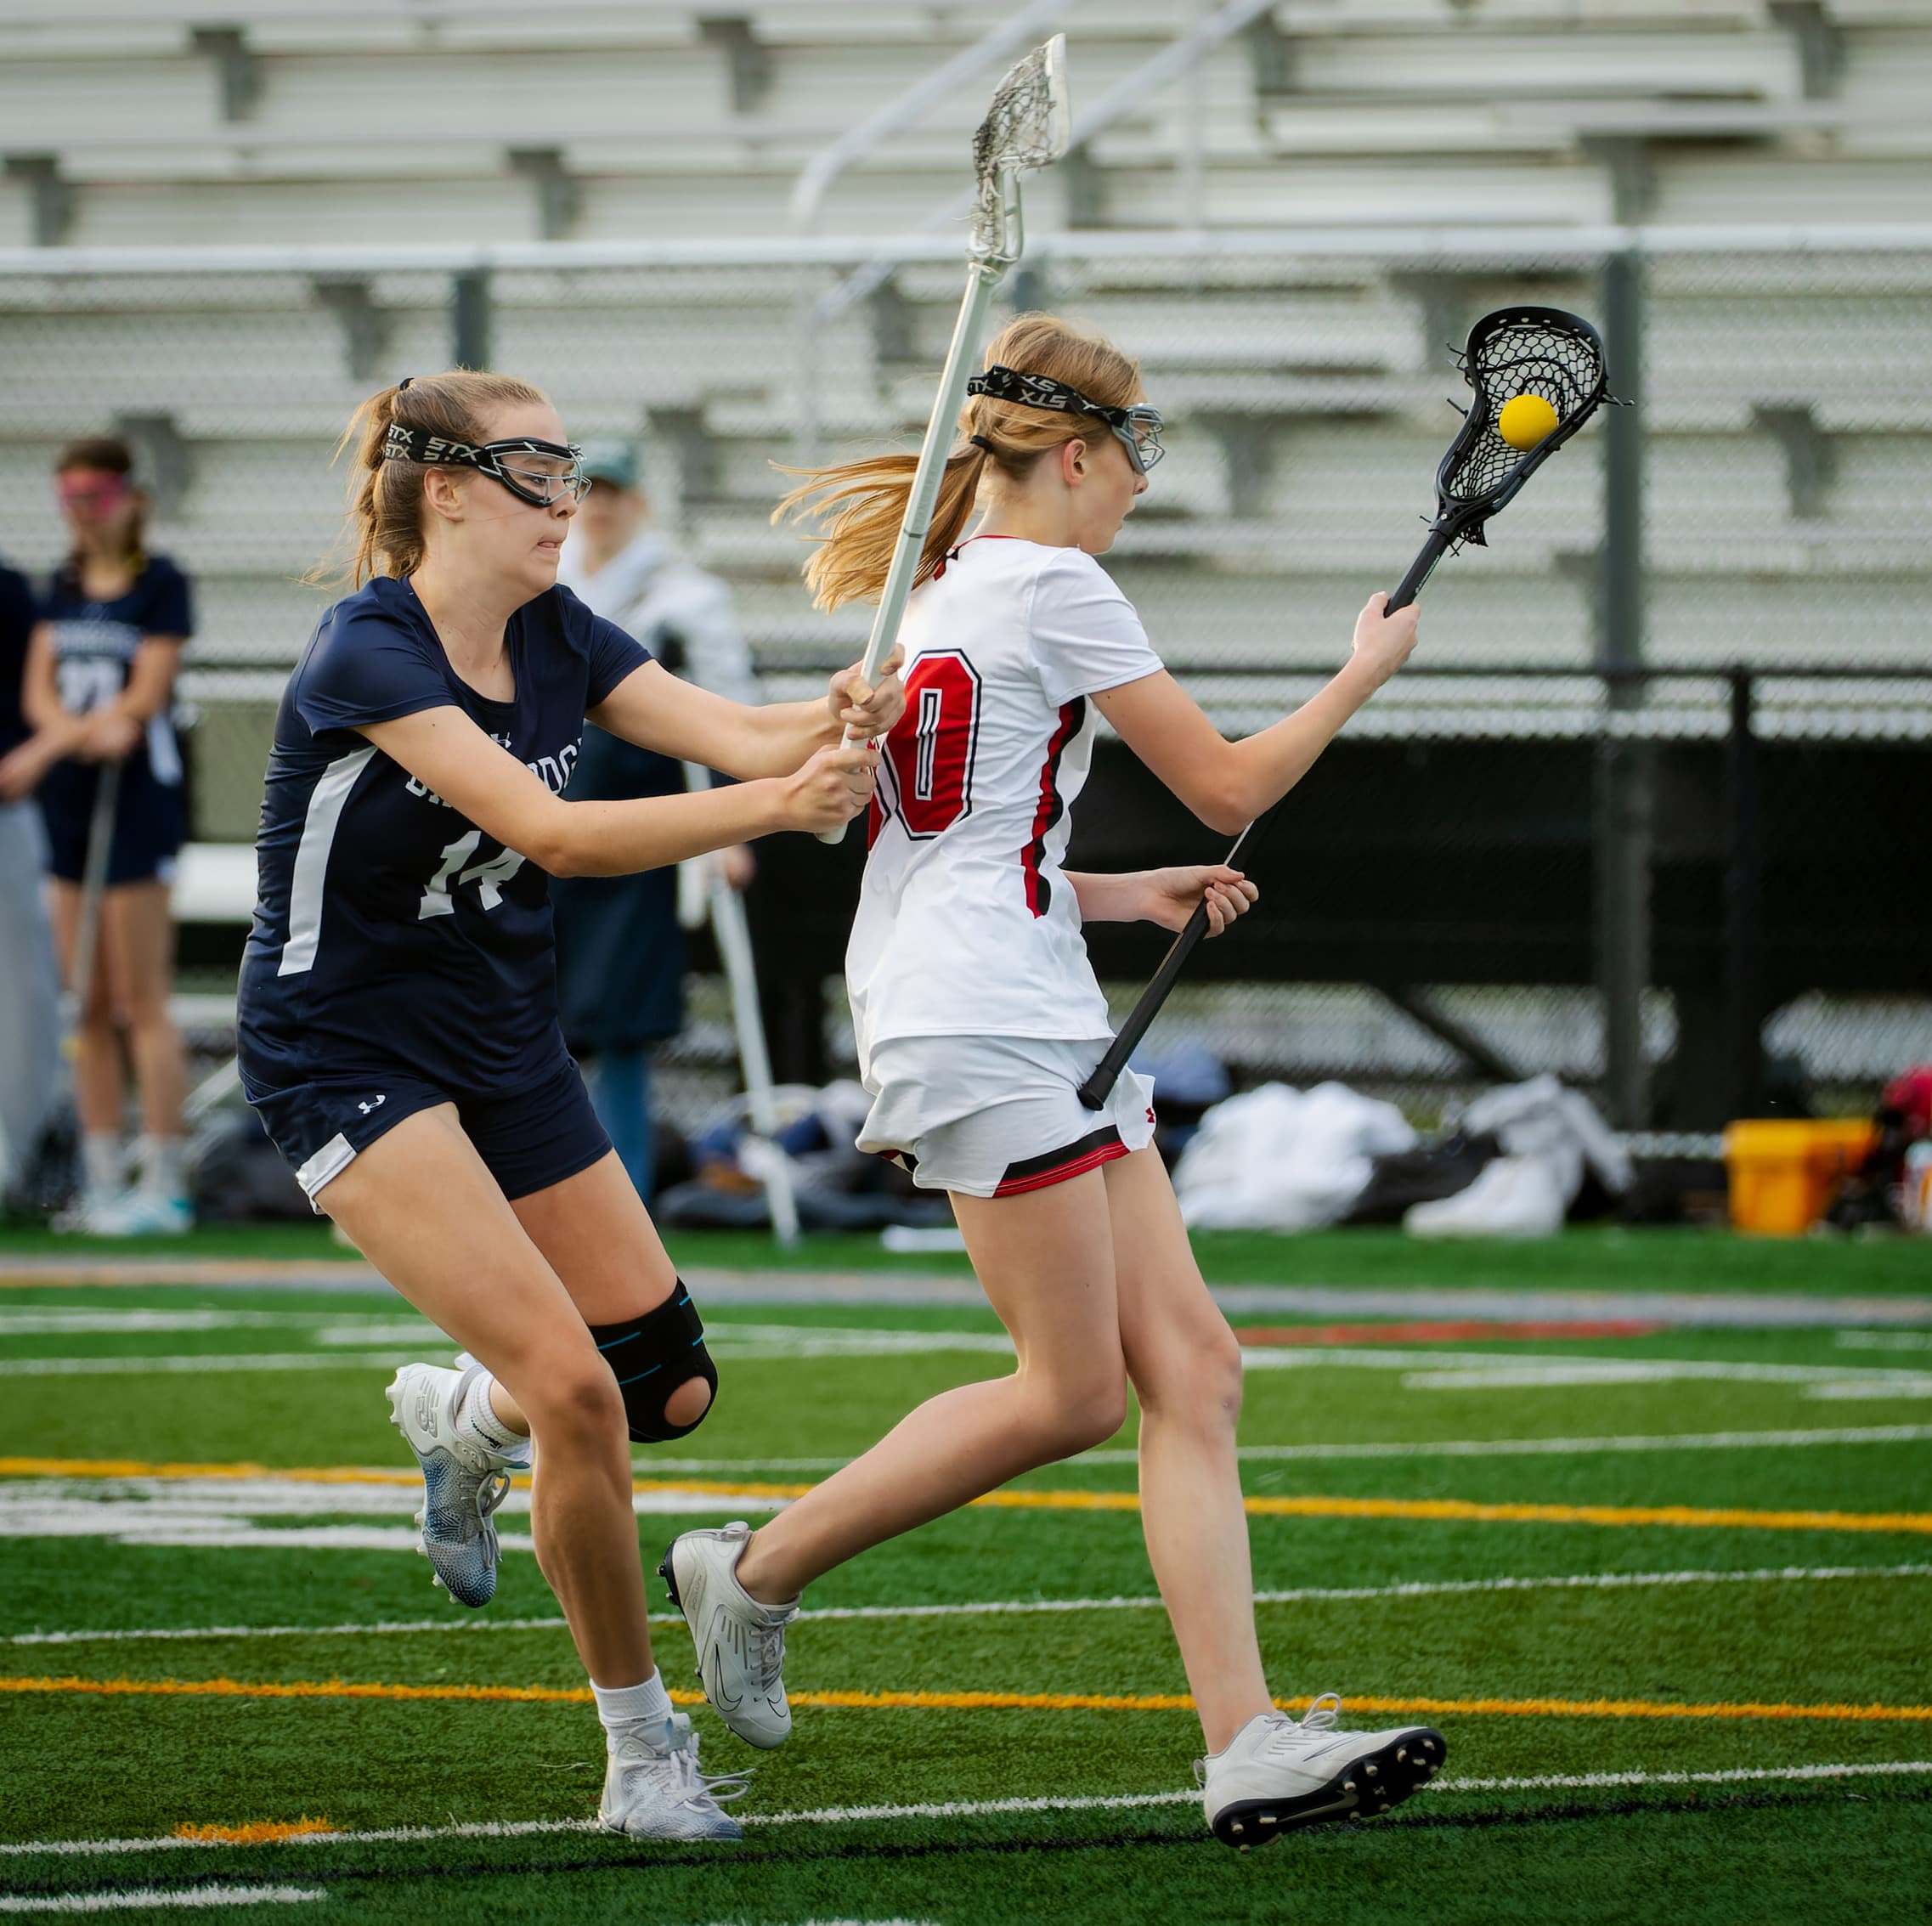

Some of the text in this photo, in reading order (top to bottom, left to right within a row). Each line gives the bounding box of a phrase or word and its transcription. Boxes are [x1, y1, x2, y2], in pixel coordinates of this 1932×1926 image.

[1018, 389, 1067, 409] STX
[426, 436, 481, 461] STX
[867, 648, 982, 850] 0
[418, 830, 526, 920] 14
